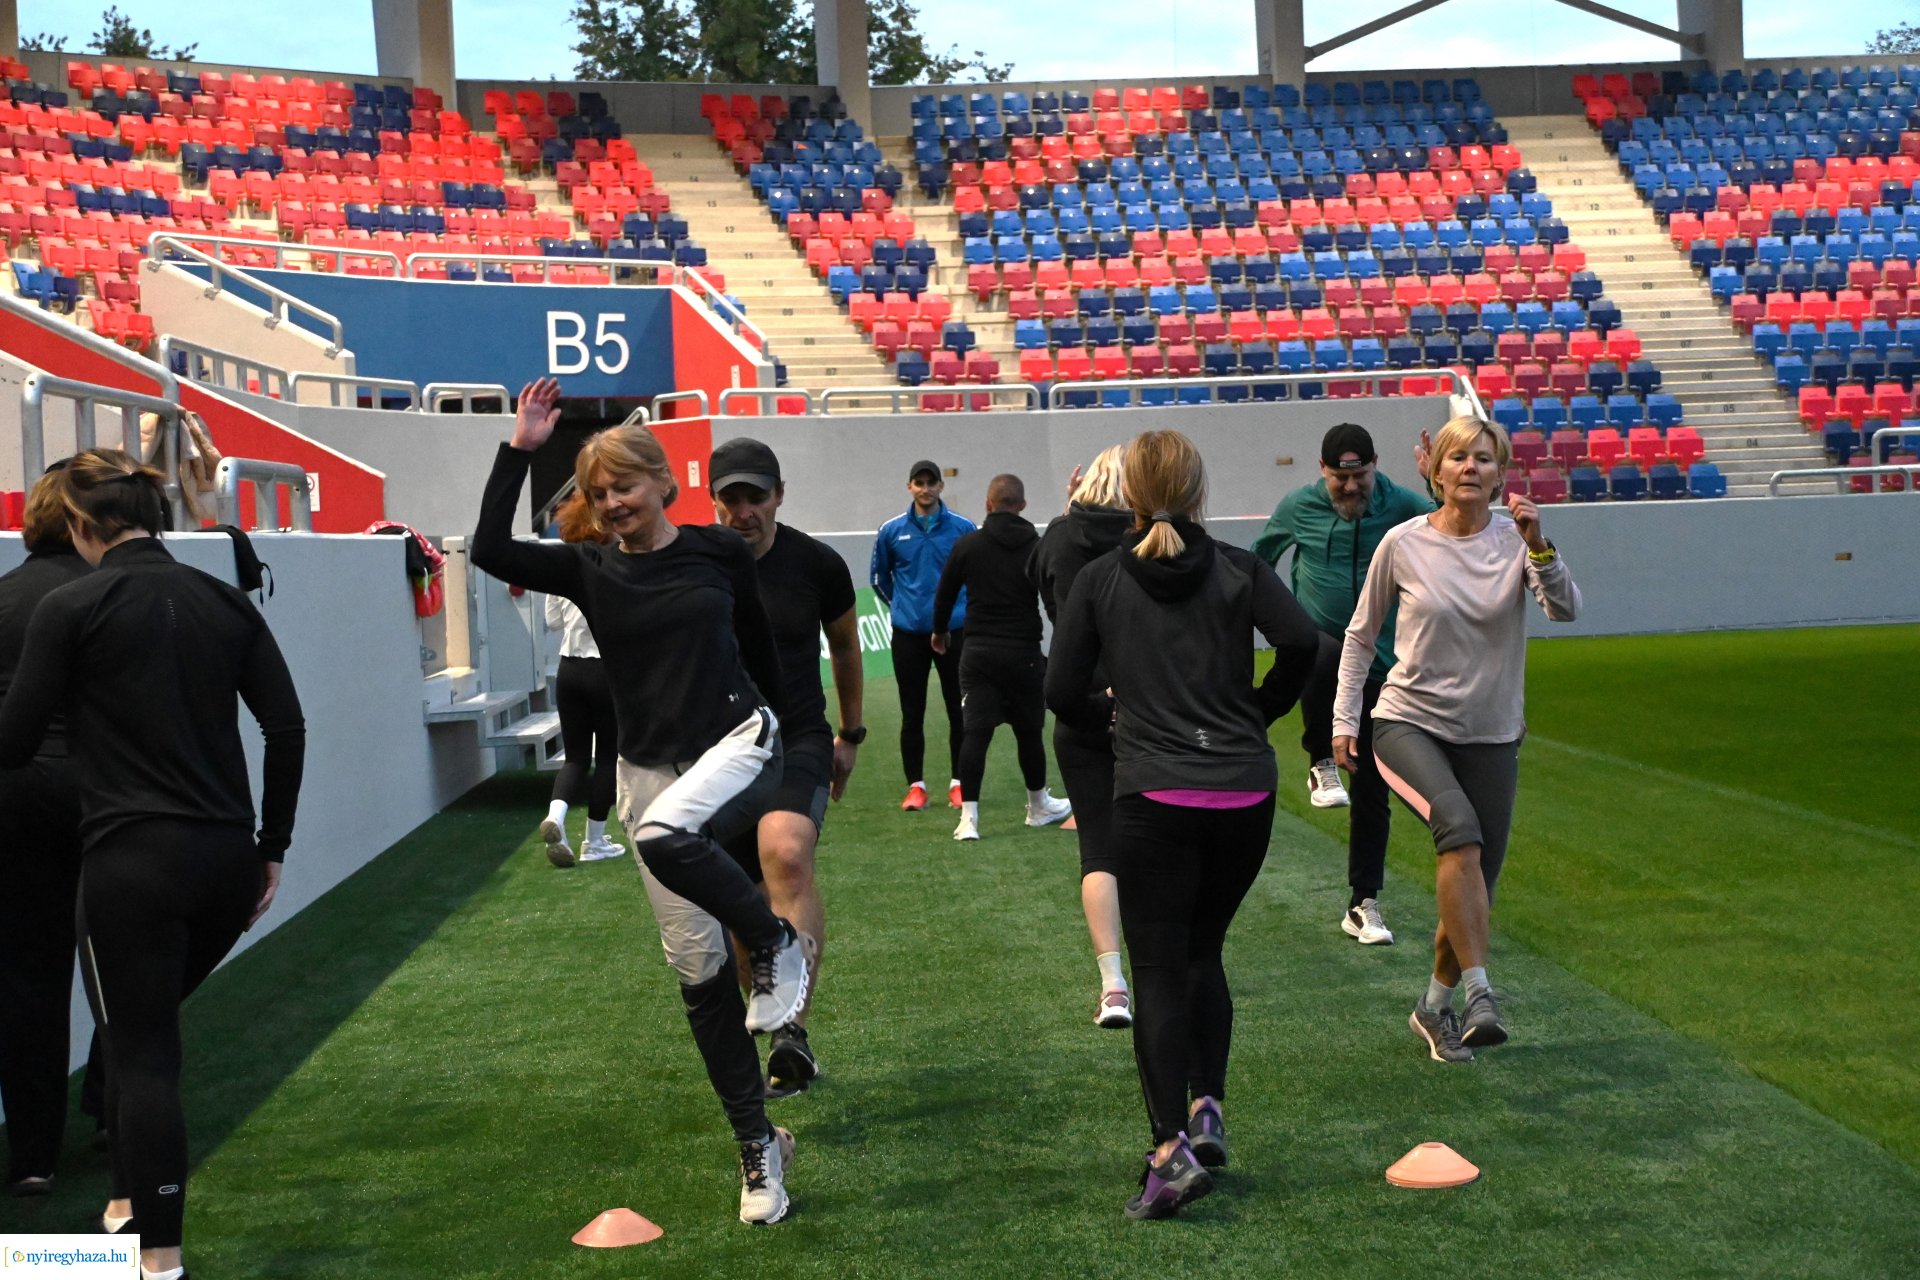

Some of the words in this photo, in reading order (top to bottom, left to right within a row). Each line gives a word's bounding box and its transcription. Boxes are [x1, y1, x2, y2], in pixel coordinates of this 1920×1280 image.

[1590, 203, 1600, 211] 12
[725, 226, 735, 234] 12
[1608, 228, 1617, 236] 11
[1642, 282, 1653, 290] 09
[1660, 311, 1671, 319] 08
[546, 311, 630, 375] B5
[1680, 340, 1691, 348] 07
[1702, 371, 1713, 380] 06
[1723, 404, 1735, 413] 05
[1746, 438, 1758, 447] 04
